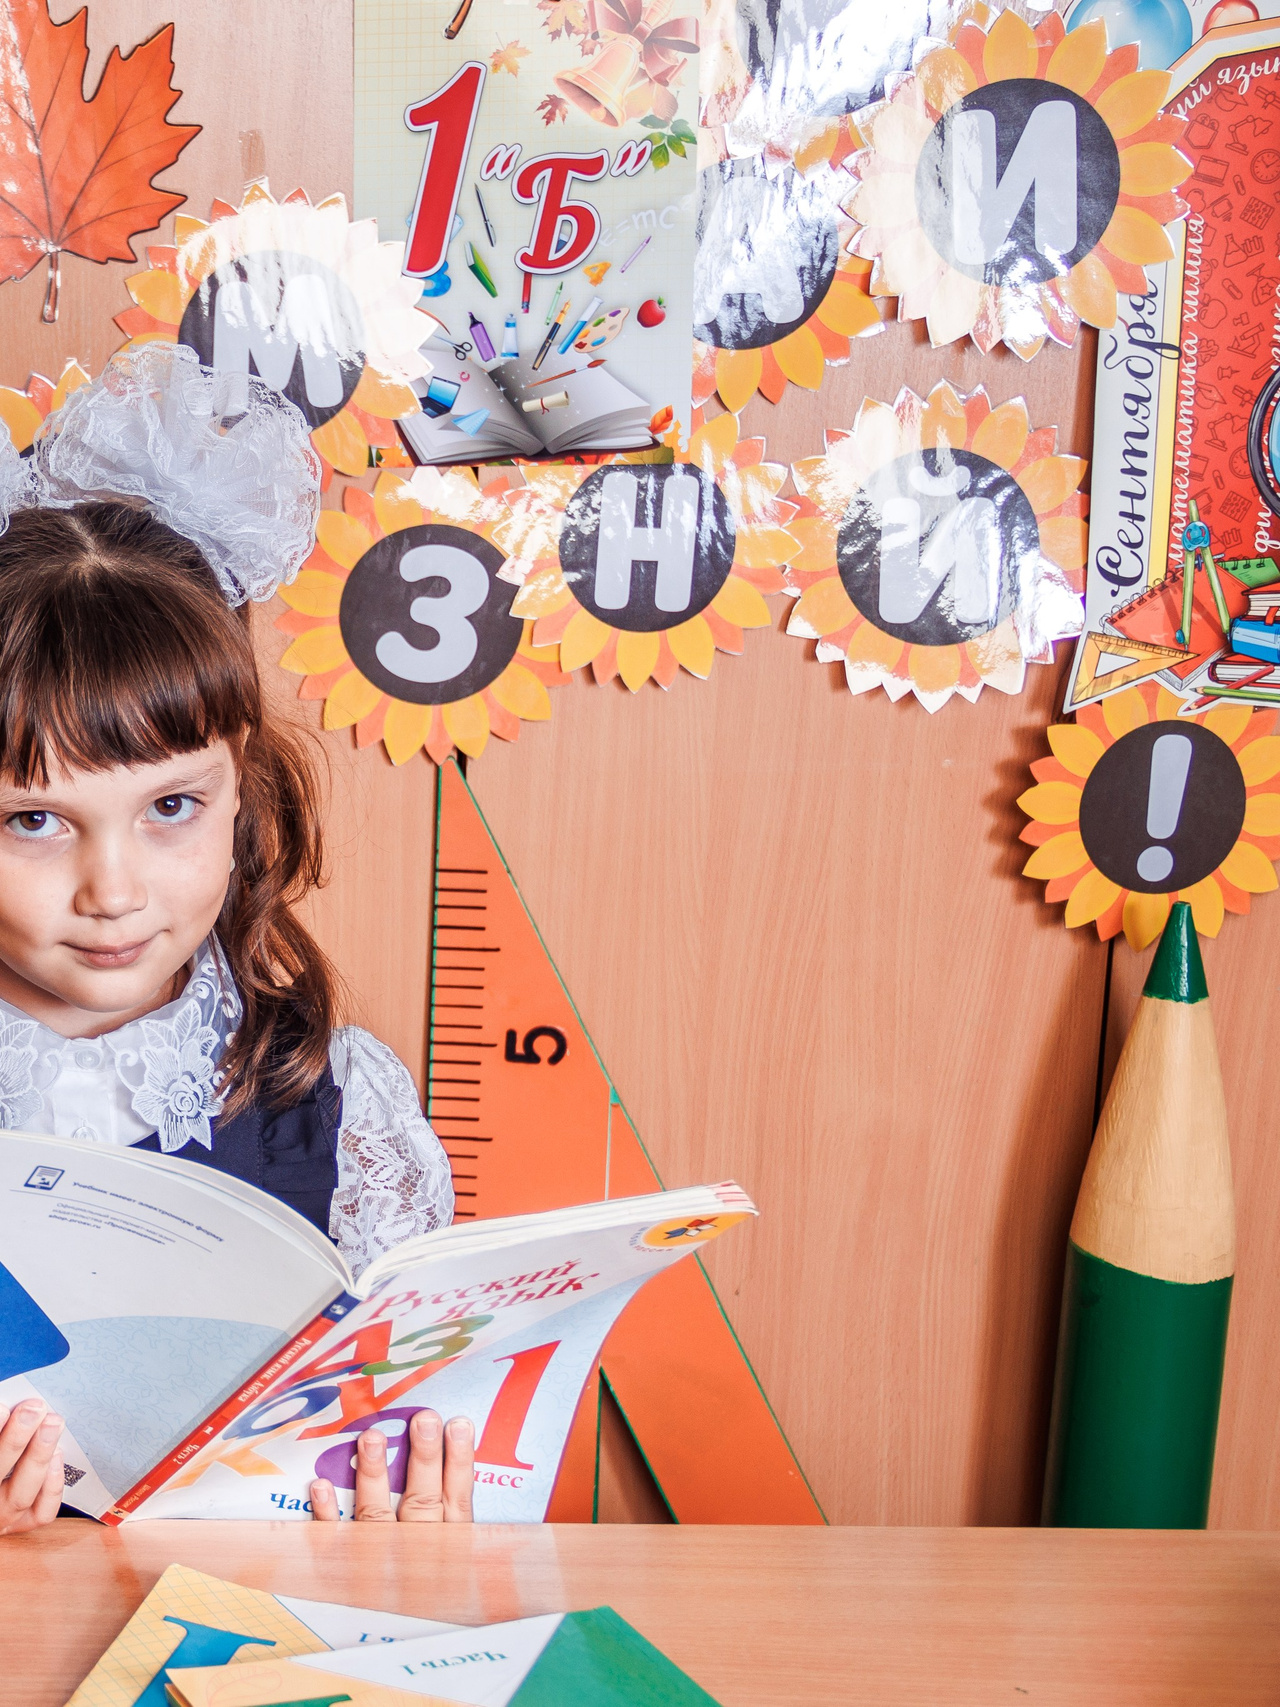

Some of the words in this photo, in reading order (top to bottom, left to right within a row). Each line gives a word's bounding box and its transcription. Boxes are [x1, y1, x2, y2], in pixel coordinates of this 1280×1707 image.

[401, 61, 488, 280] 1
[951, 100, 1078, 266] И
[593, 471, 701, 613] Н
[878, 463, 1005, 625] Й
[375, 543, 490, 685] З
[1135, 733, 1193, 884] !
[504, 1024, 569, 1067] 5
[366, 1257, 584, 1322] Русский
[421, 1649, 511, 1670] Часть
